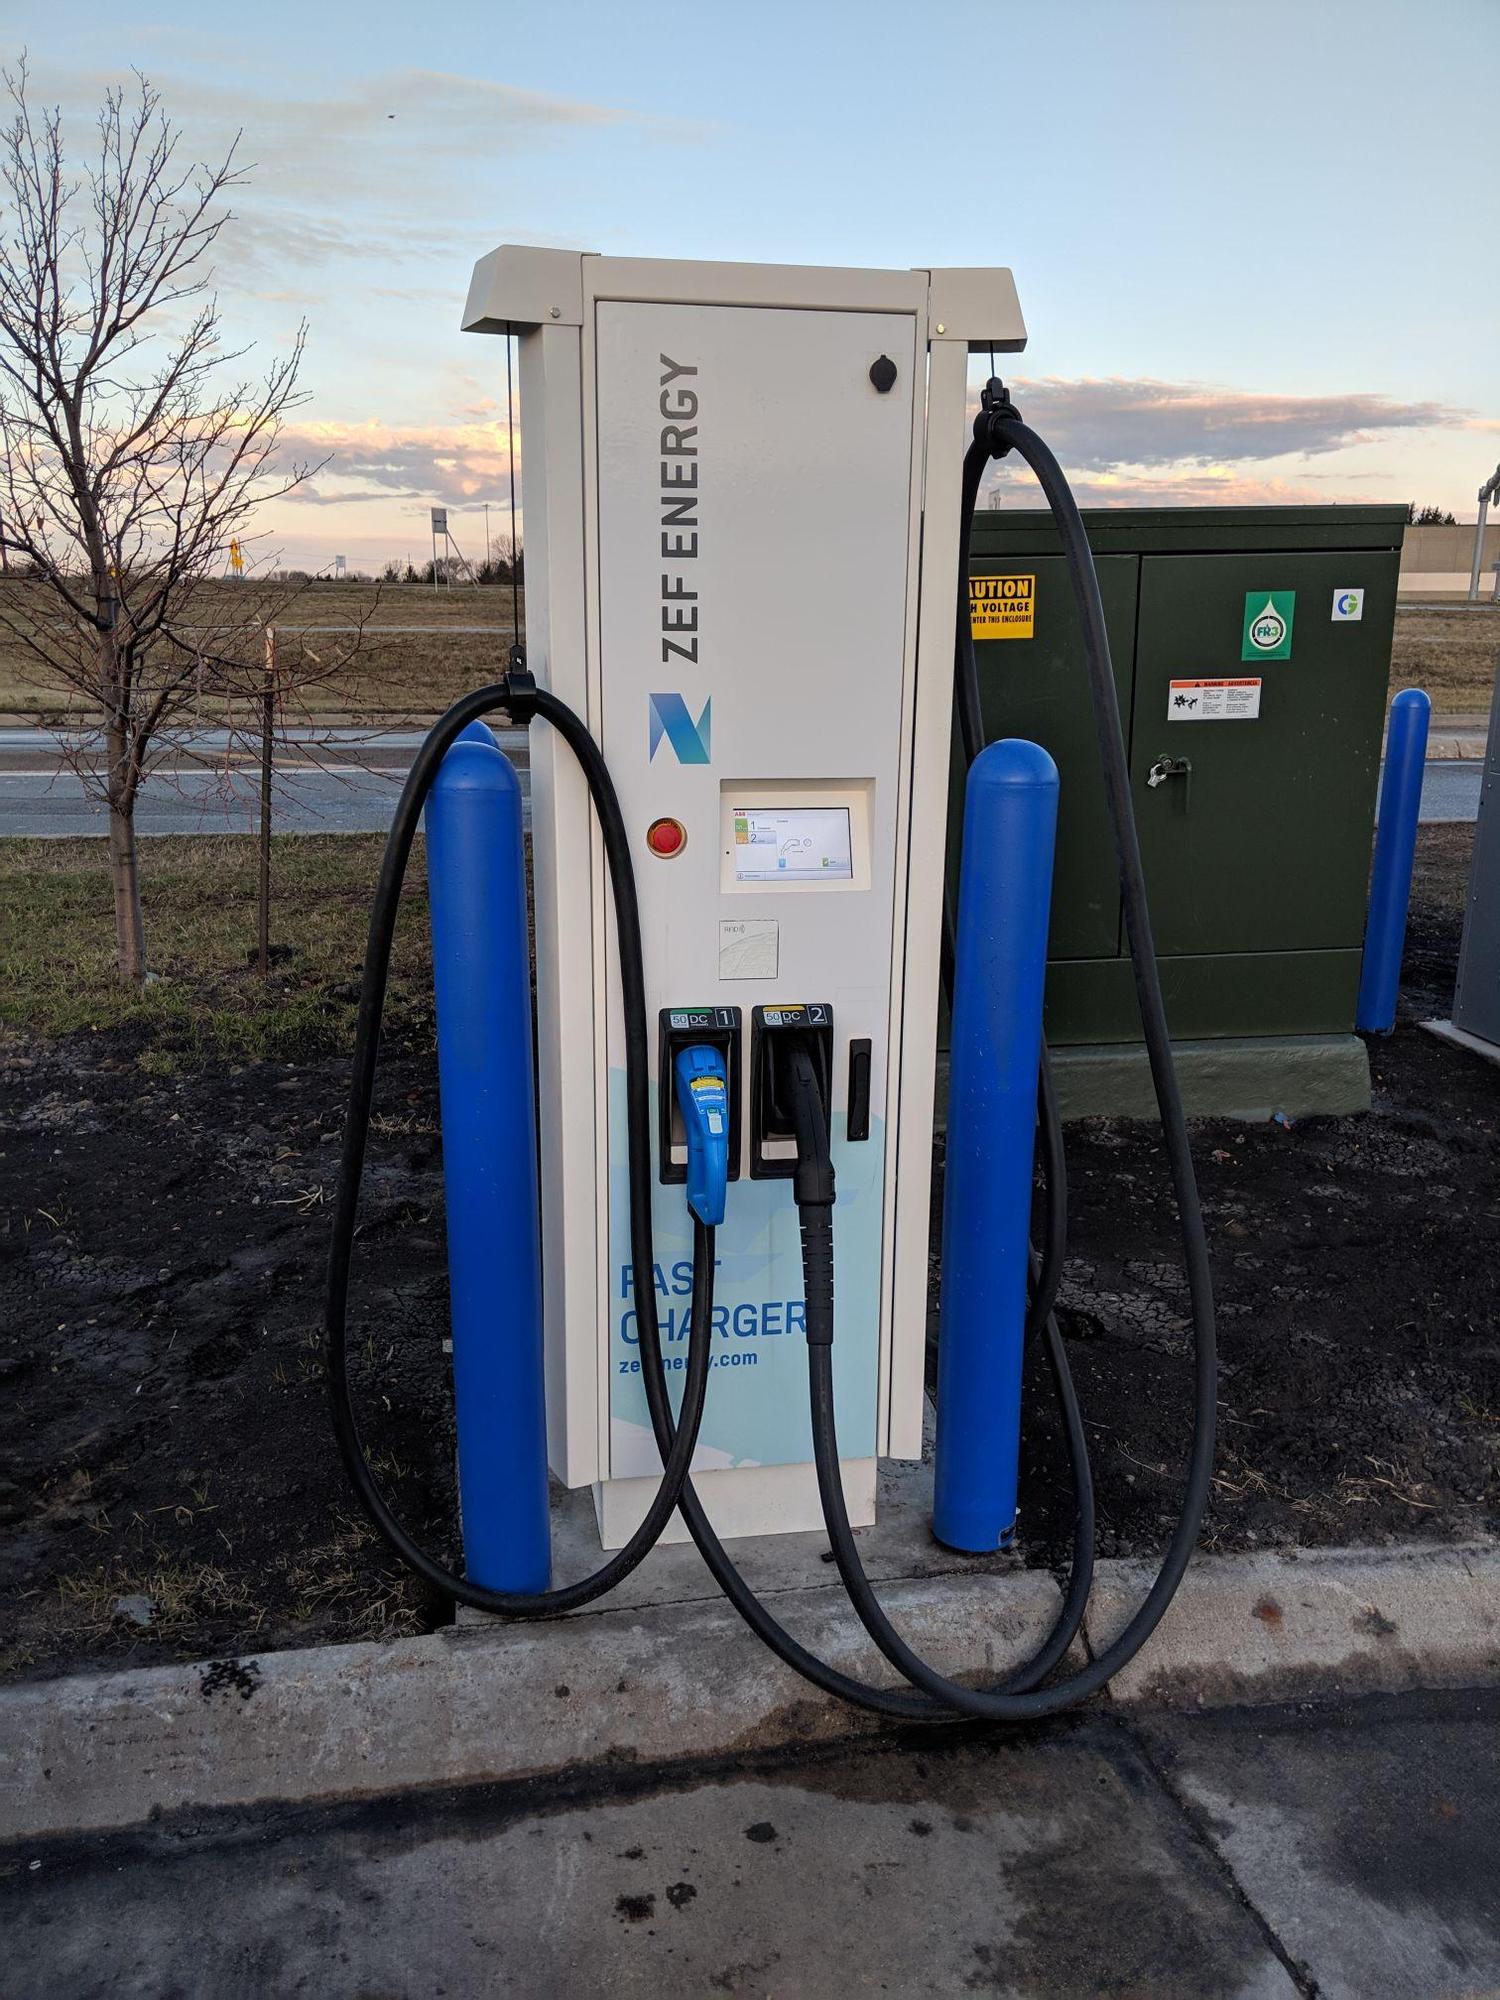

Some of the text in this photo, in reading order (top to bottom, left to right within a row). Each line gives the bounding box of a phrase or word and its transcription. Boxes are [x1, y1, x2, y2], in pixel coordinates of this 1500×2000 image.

[659, 352, 699, 665] ZEF ENERGY
[969, 580, 1029, 598] UTION
[982, 602, 1030, 613] VOLTAGE
[971, 616, 987, 624] NTER
[1002, 615, 1032, 623] ENCLOSURE
[1257, 624, 1279, 636] FR3
[672, 1010, 729, 1025] 50 DC 1
[766, 1007, 825, 1022] 50 DC 2
[621, 1260, 722, 1299] FAS
